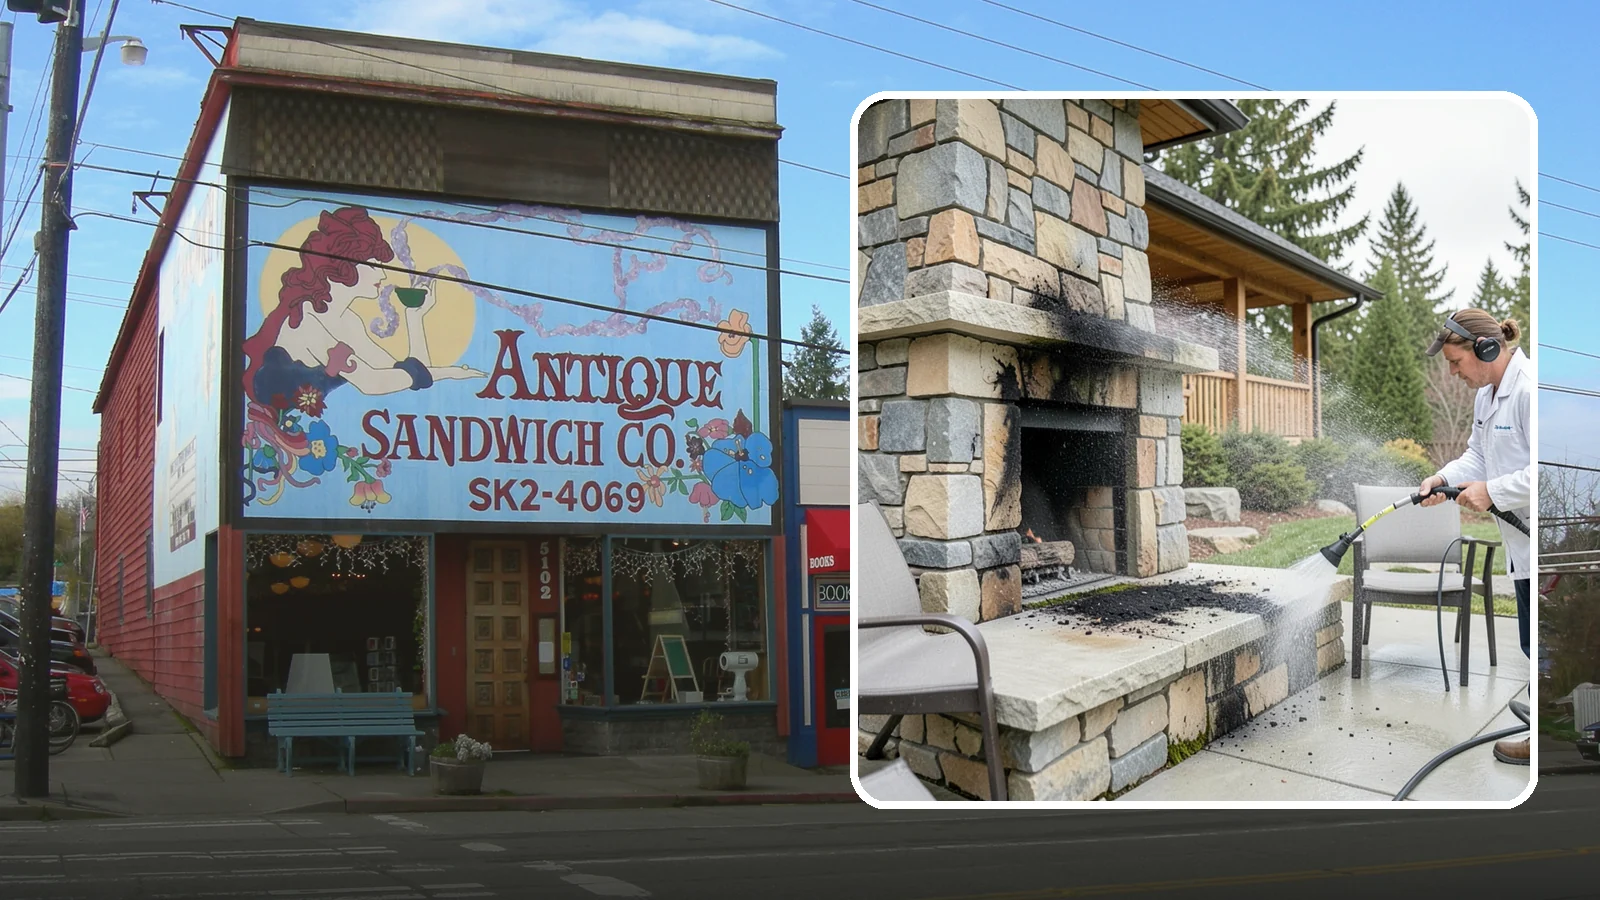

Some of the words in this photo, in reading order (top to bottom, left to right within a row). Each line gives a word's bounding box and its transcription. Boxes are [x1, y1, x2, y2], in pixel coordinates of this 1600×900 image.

[476, 328, 724, 421] ANTIQUE
[361, 408, 605, 468] SANDWICH
[616, 421, 685, 469] CO.
[468, 476, 647, 514] SK2-4069
[539, 541, 552, 600] 5102
[809, 555, 835, 569] BOOKS
